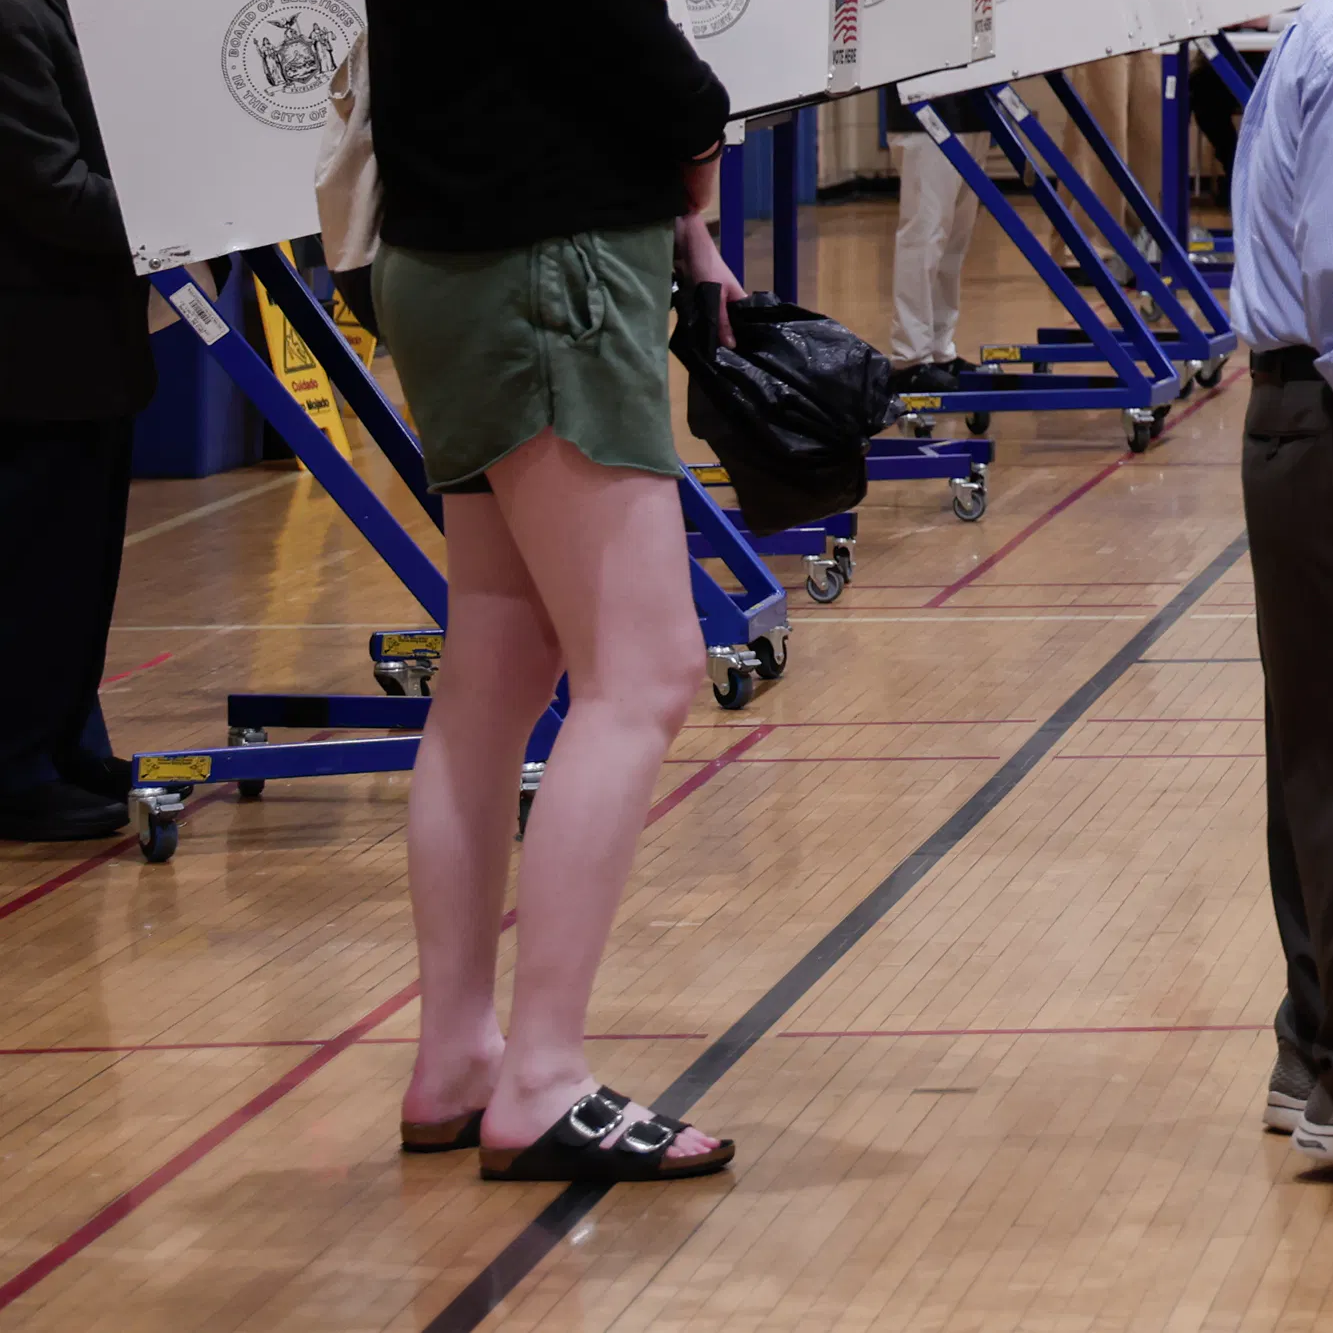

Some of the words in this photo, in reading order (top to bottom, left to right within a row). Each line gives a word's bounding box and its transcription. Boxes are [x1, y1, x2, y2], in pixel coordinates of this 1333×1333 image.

[229, 11, 257, 57] BOARD
[232, 74, 246, 90] IN
[243, 89, 268, 114] THE
[270, 109, 306, 124] CITY
[309, 106, 328, 122] OF
[292, 379, 319, 393] Cuidado
